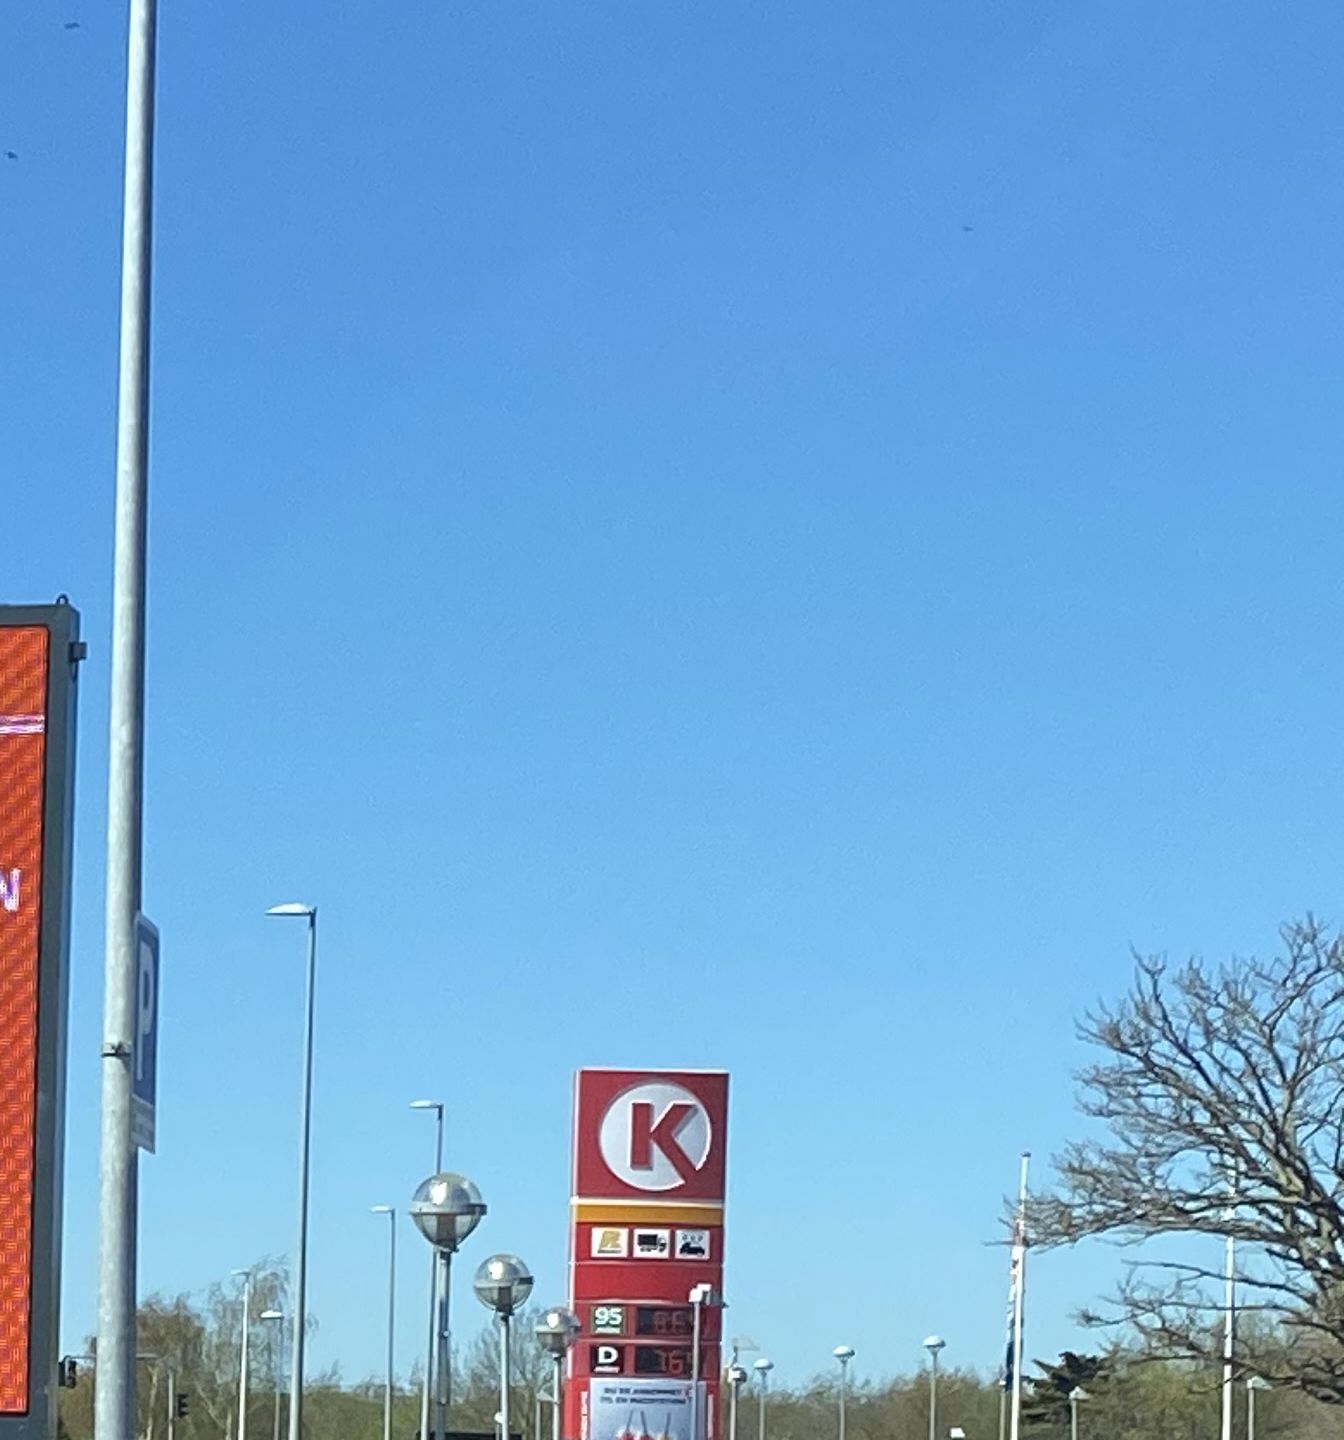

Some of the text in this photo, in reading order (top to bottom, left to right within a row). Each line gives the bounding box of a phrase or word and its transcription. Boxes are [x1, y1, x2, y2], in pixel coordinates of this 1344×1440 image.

[630, 1102, 697, 1184] K
[595, 1307, 622, 1325] 95
[598, 1346, 618, 1364] D
